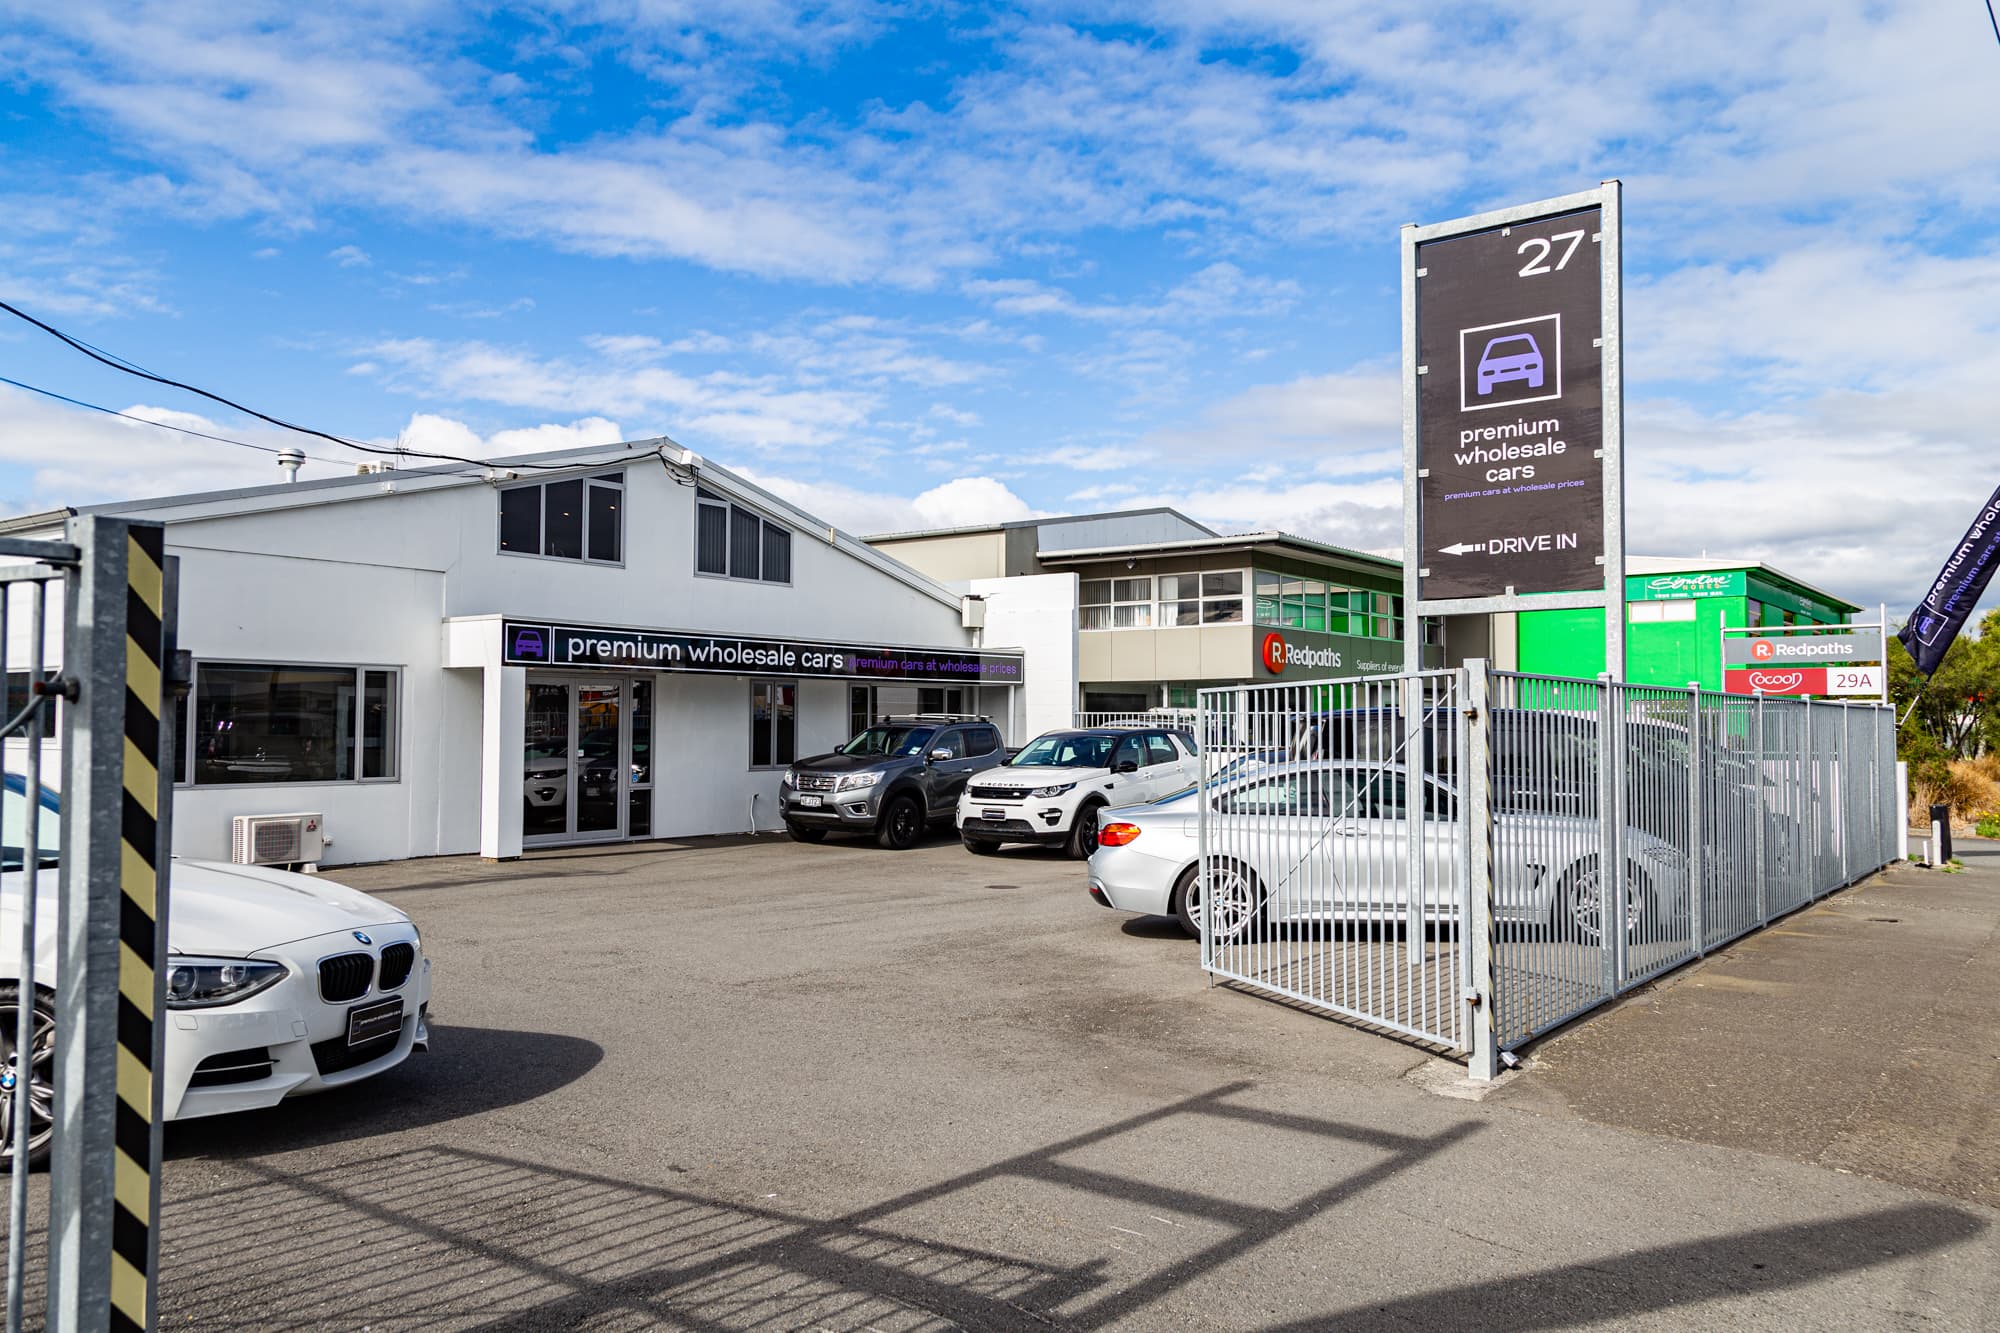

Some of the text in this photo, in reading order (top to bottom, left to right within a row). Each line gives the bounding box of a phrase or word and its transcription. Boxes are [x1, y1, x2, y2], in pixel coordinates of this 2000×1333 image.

[1517, 229, 1585, 278] 27
[1460, 418, 1559, 448] premium
[1454, 436, 1567, 465] wholesale
[1485, 464, 1535, 482] cars
[1444, 490, 1480, 501] premium
[1482, 488, 1501, 496] cars
[1513, 482, 1556, 493] wholesale
[1557, 479, 1585, 490] prices
[1488, 533, 1577, 555] DRIVE IN
[1927, 543, 1974, 603] premium
[1944, 567, 1979, 611] premium
[1977, 545, 1996, 565] cars
[567, 636, 844, 669] premium wholesale cars
[1285, 644, 1341, 669] Redpaths
[1776, 642, 1853, 657] Redpaths
[848, 656, 1017, 676] premium cars at wholesale prices
[1749, 672, 1803, 691] Cocoon
[1836, 674, 1872, 688] 29A
